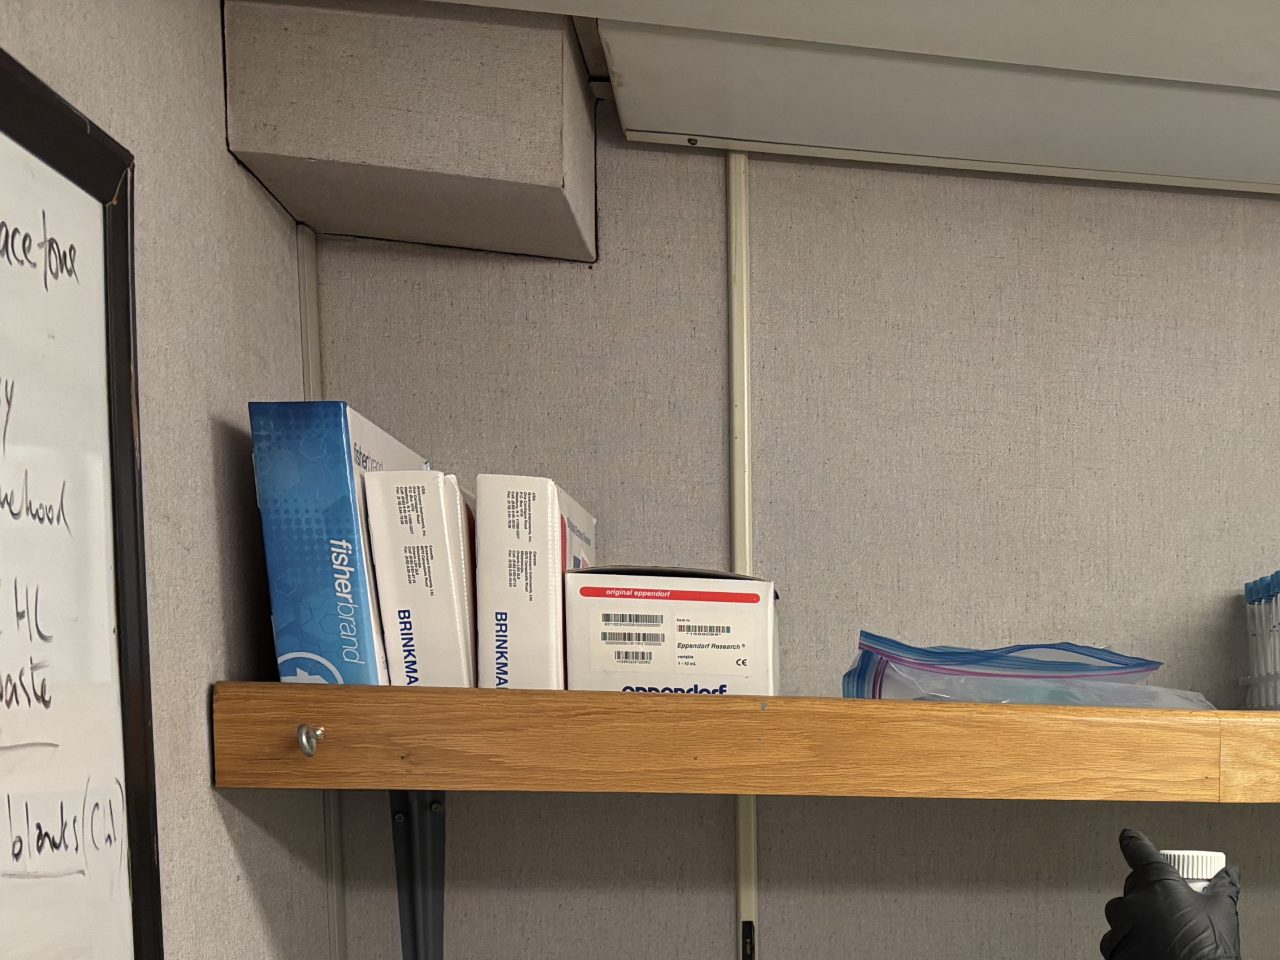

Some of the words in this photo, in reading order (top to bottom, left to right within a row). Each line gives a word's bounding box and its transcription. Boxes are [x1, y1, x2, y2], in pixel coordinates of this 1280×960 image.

[330, 539, 366, 664] fisherbrand
[634, 590, 671, 598] eppendorf
[495, 611, 509, 689] BRINKMA
